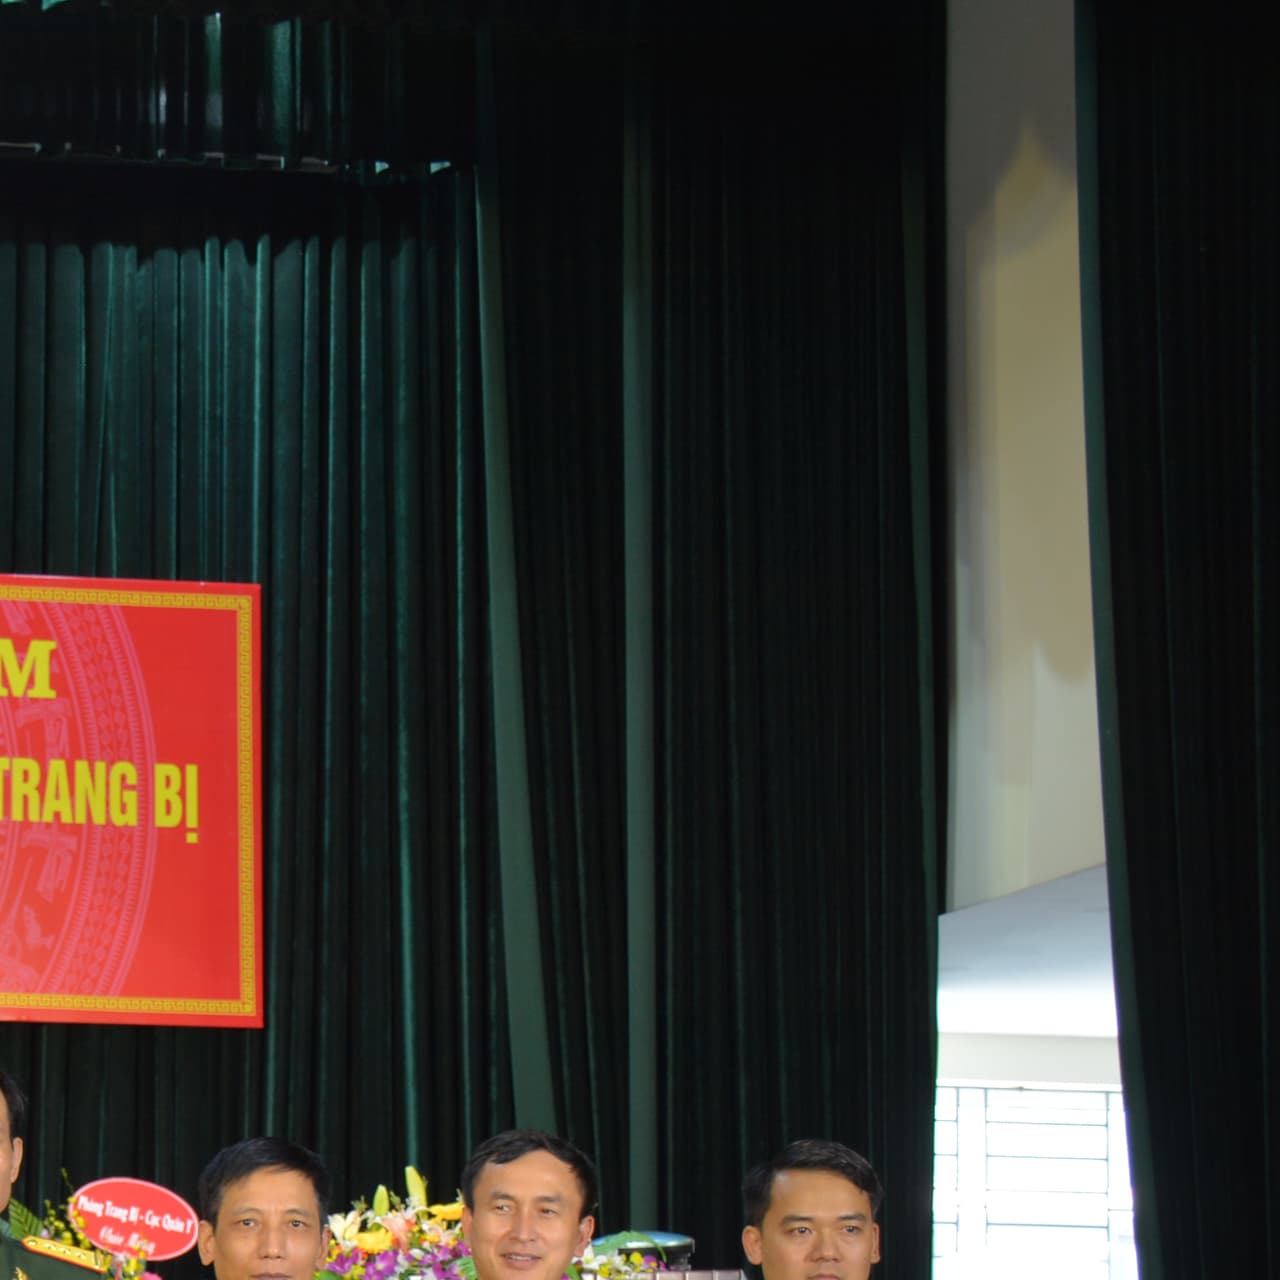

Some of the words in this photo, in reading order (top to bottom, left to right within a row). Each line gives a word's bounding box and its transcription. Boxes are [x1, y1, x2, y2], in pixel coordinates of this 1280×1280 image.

[154, 762, 199, 843] BỊ
[78, 1195, 104, 1218] Phòng
[105, 1201, 129, 1223] Trang
